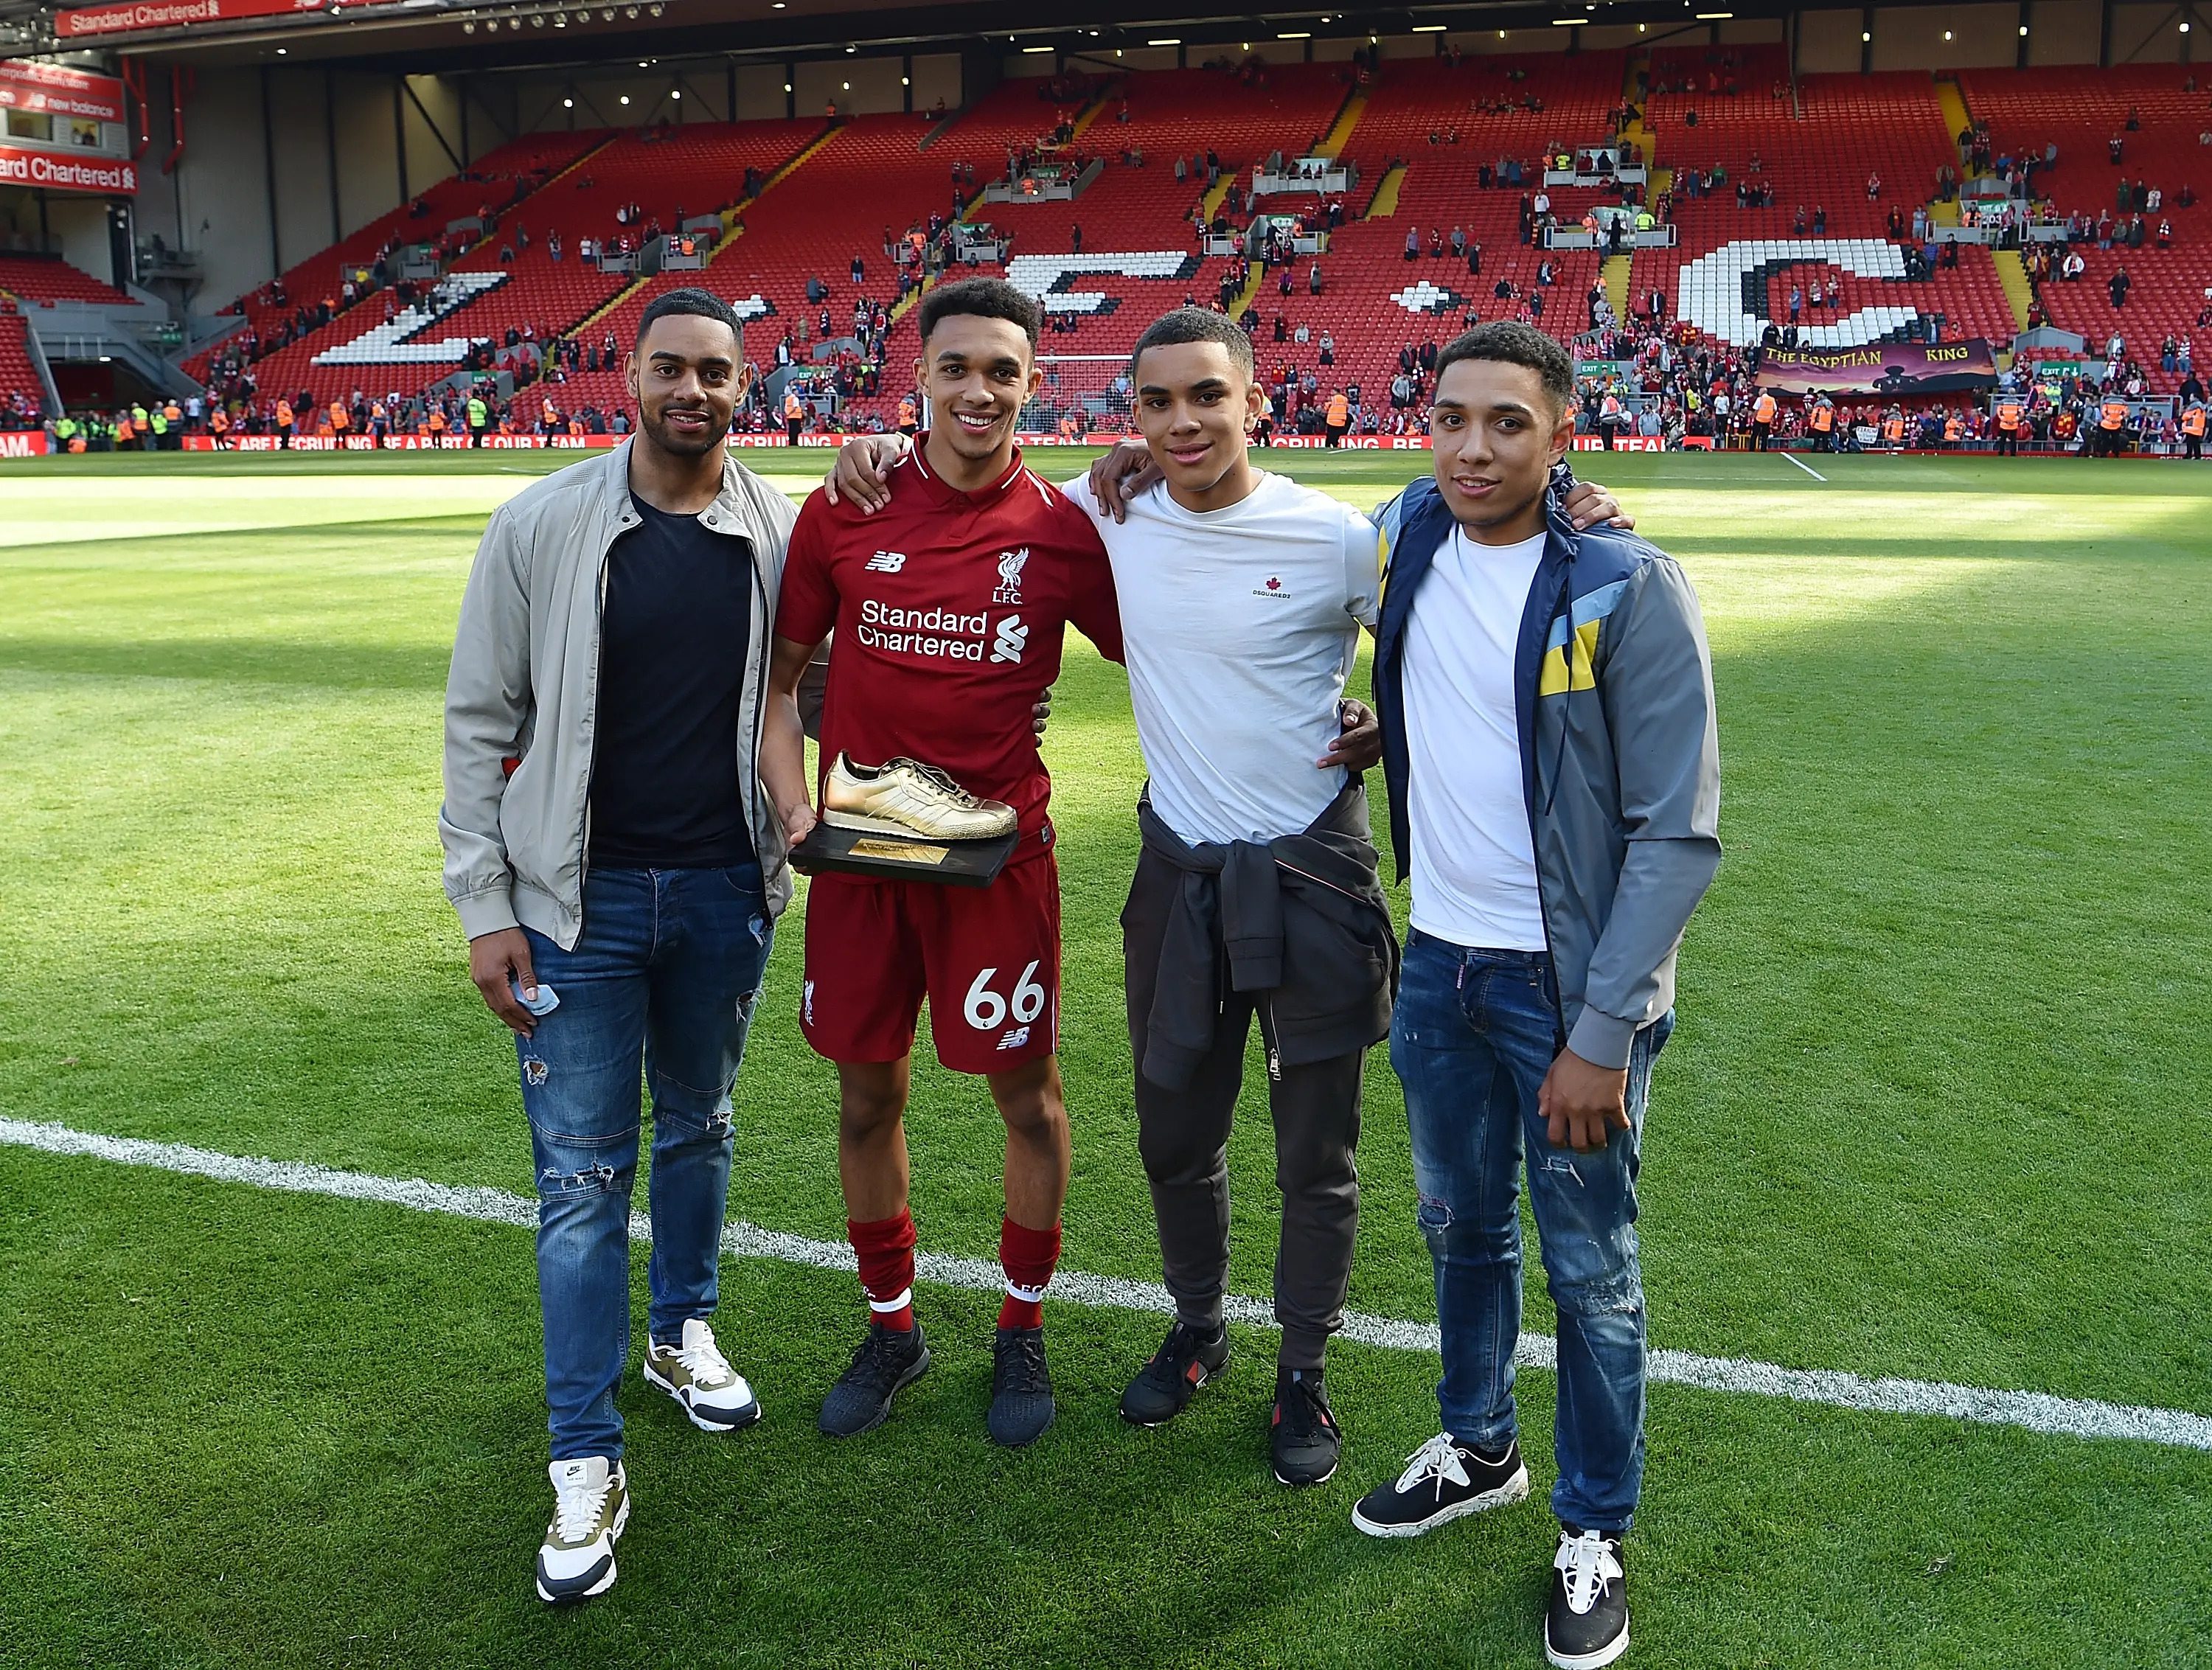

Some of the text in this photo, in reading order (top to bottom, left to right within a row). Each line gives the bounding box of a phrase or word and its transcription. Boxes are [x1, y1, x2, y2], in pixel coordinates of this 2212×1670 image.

[70, 1, 206, 32] Standard Chartered
[31, 157, 119, 187] Chartered
[1766, 347, 1969, 369] THE EGYPTIAN KING
[240, 437, 271, 450] ARE
[406, 436, 417, 449] A
[494, 436, 532, 448] OUR
[536, 436, 585, 448] TEAM
[725, 436, 832, 448] ECRUIING
[1393, 438, 1422, 449] BE
[1568, 439, 1604, 451] UR
[1253, 590, 1291, 599] DSQUARED2
[861, 599, 987, 634] Standard
[858, 624, 984, 661] Chartered
[964, 959, 1045, 1030] 66
